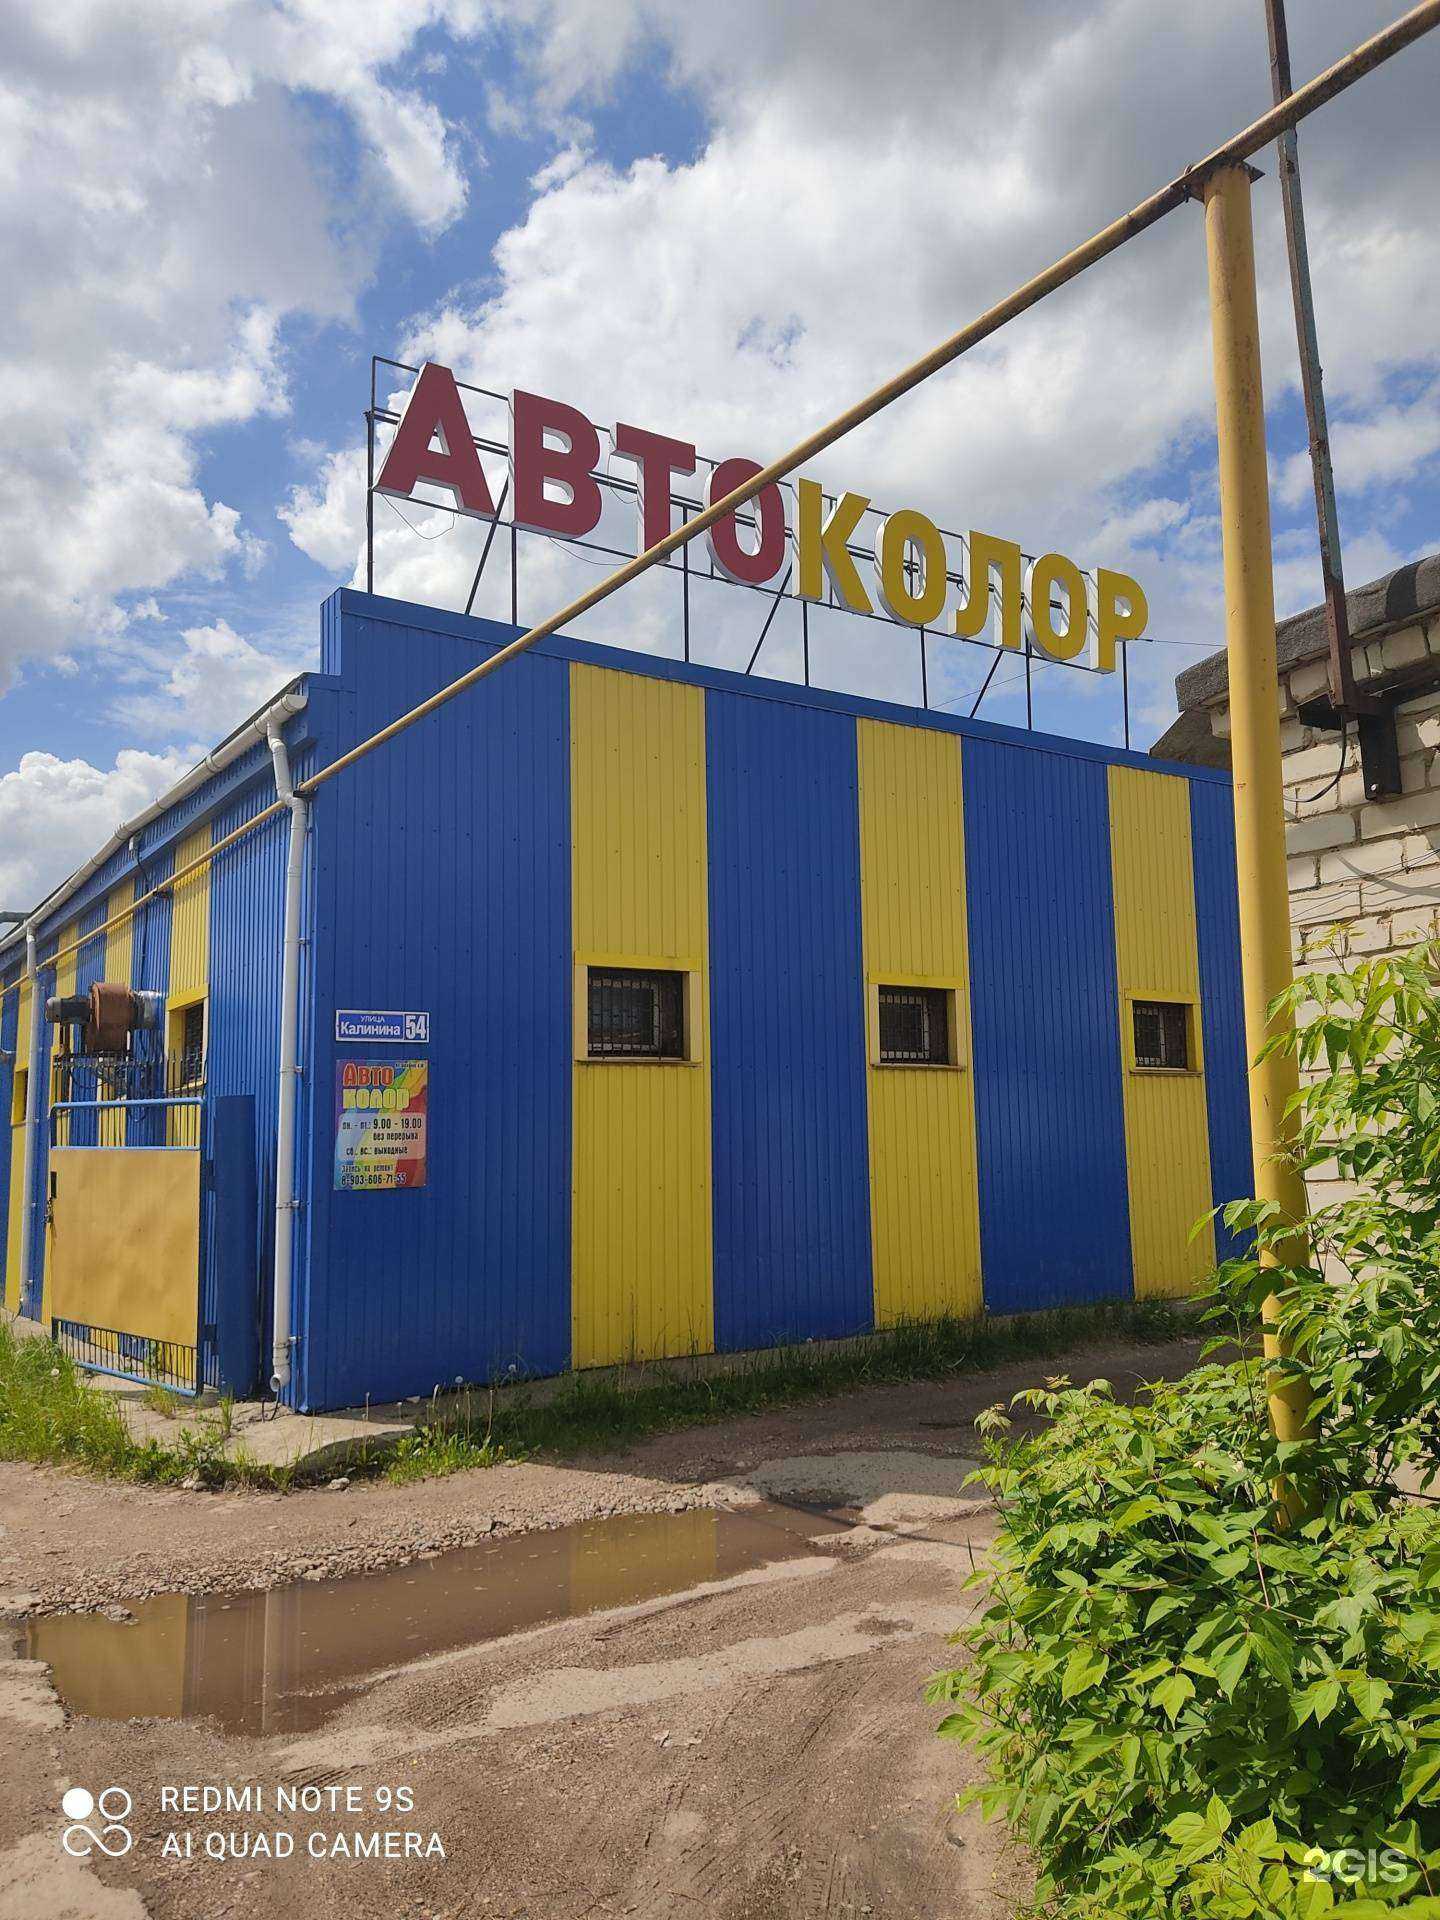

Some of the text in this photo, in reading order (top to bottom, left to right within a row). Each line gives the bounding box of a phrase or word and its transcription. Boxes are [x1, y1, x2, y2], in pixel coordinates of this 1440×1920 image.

[340, 1021, 401, 1036] Калинина
[405, 1015, 427, 1040] 54
[342, 1088, 410, 1111] КОЛОР
[373, 1118, 392, 1129] 9.00
[400, 1118, 422, 1129] 19.00
